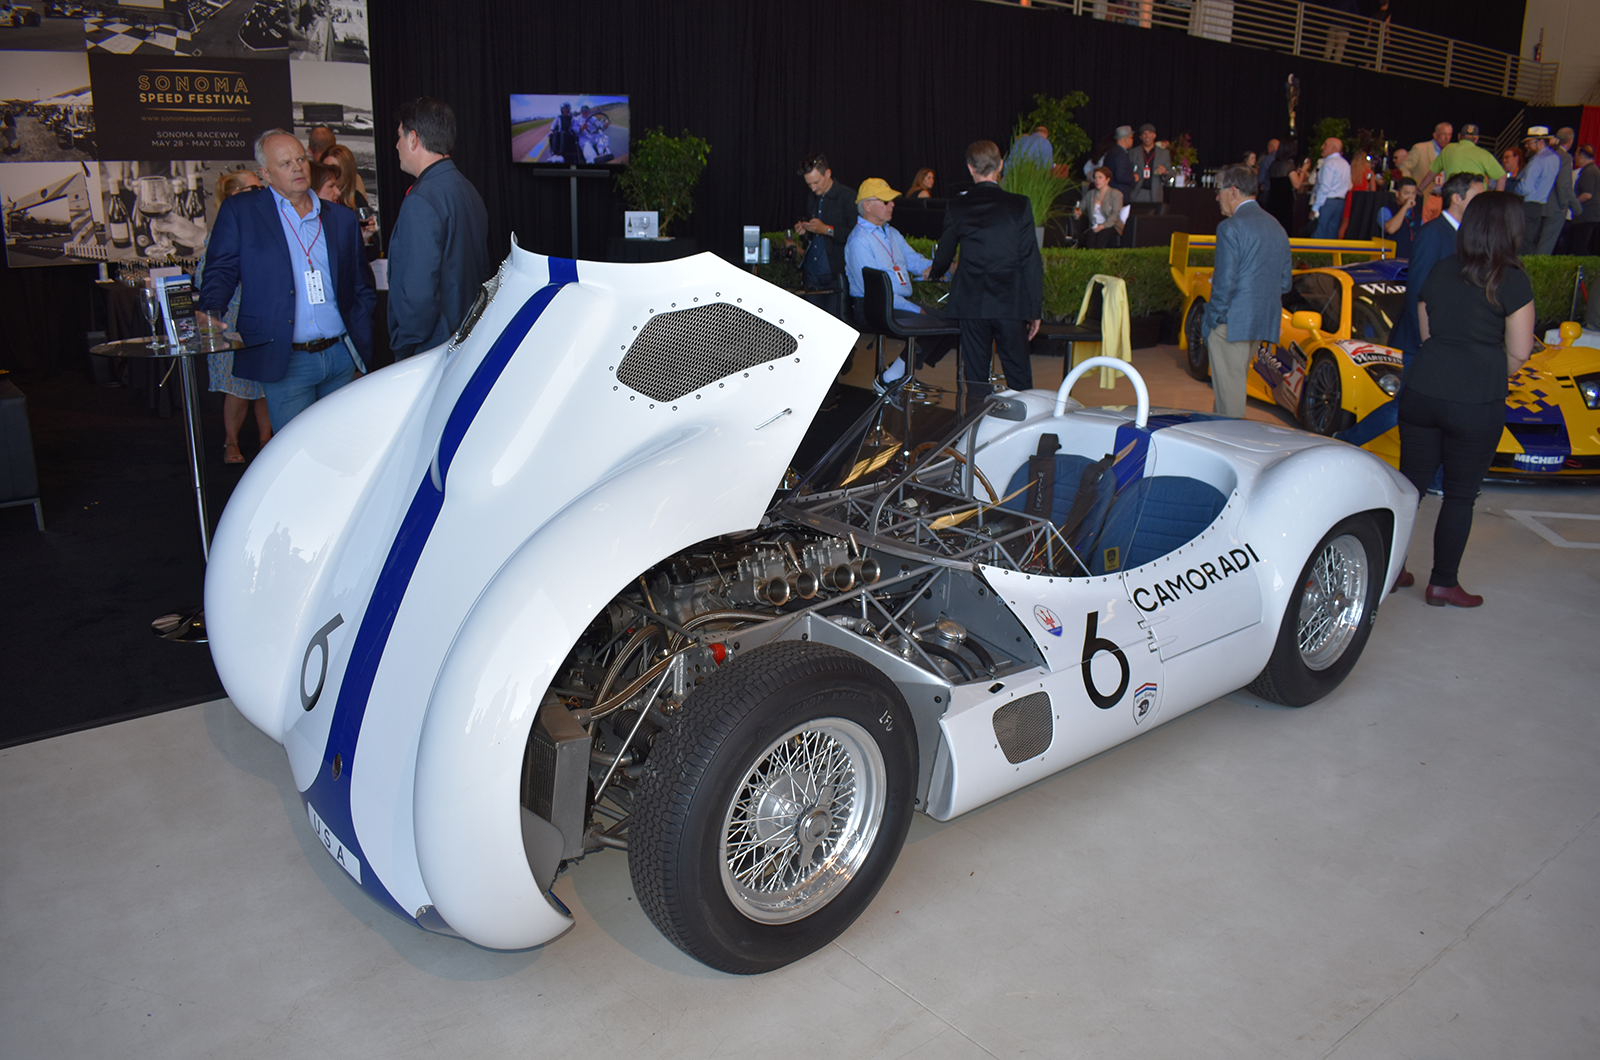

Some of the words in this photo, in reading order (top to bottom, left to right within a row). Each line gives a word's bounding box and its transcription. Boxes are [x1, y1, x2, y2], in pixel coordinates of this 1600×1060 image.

[138, 74, 249, 93] SONOMA
[139, 93, 183, 103] SPEED
[188, 94, 251, 105] FESTIVAL
[156, 131, 195, 139] SONOMA
[197, 131, 240, 139] RACEWAY
[1132, 543, 1260, 612] CAMORADI
[300, 613, 345, 712] 6
[1081, 611, 1130, 710] 6
[313, 812, 346, 867] USA
